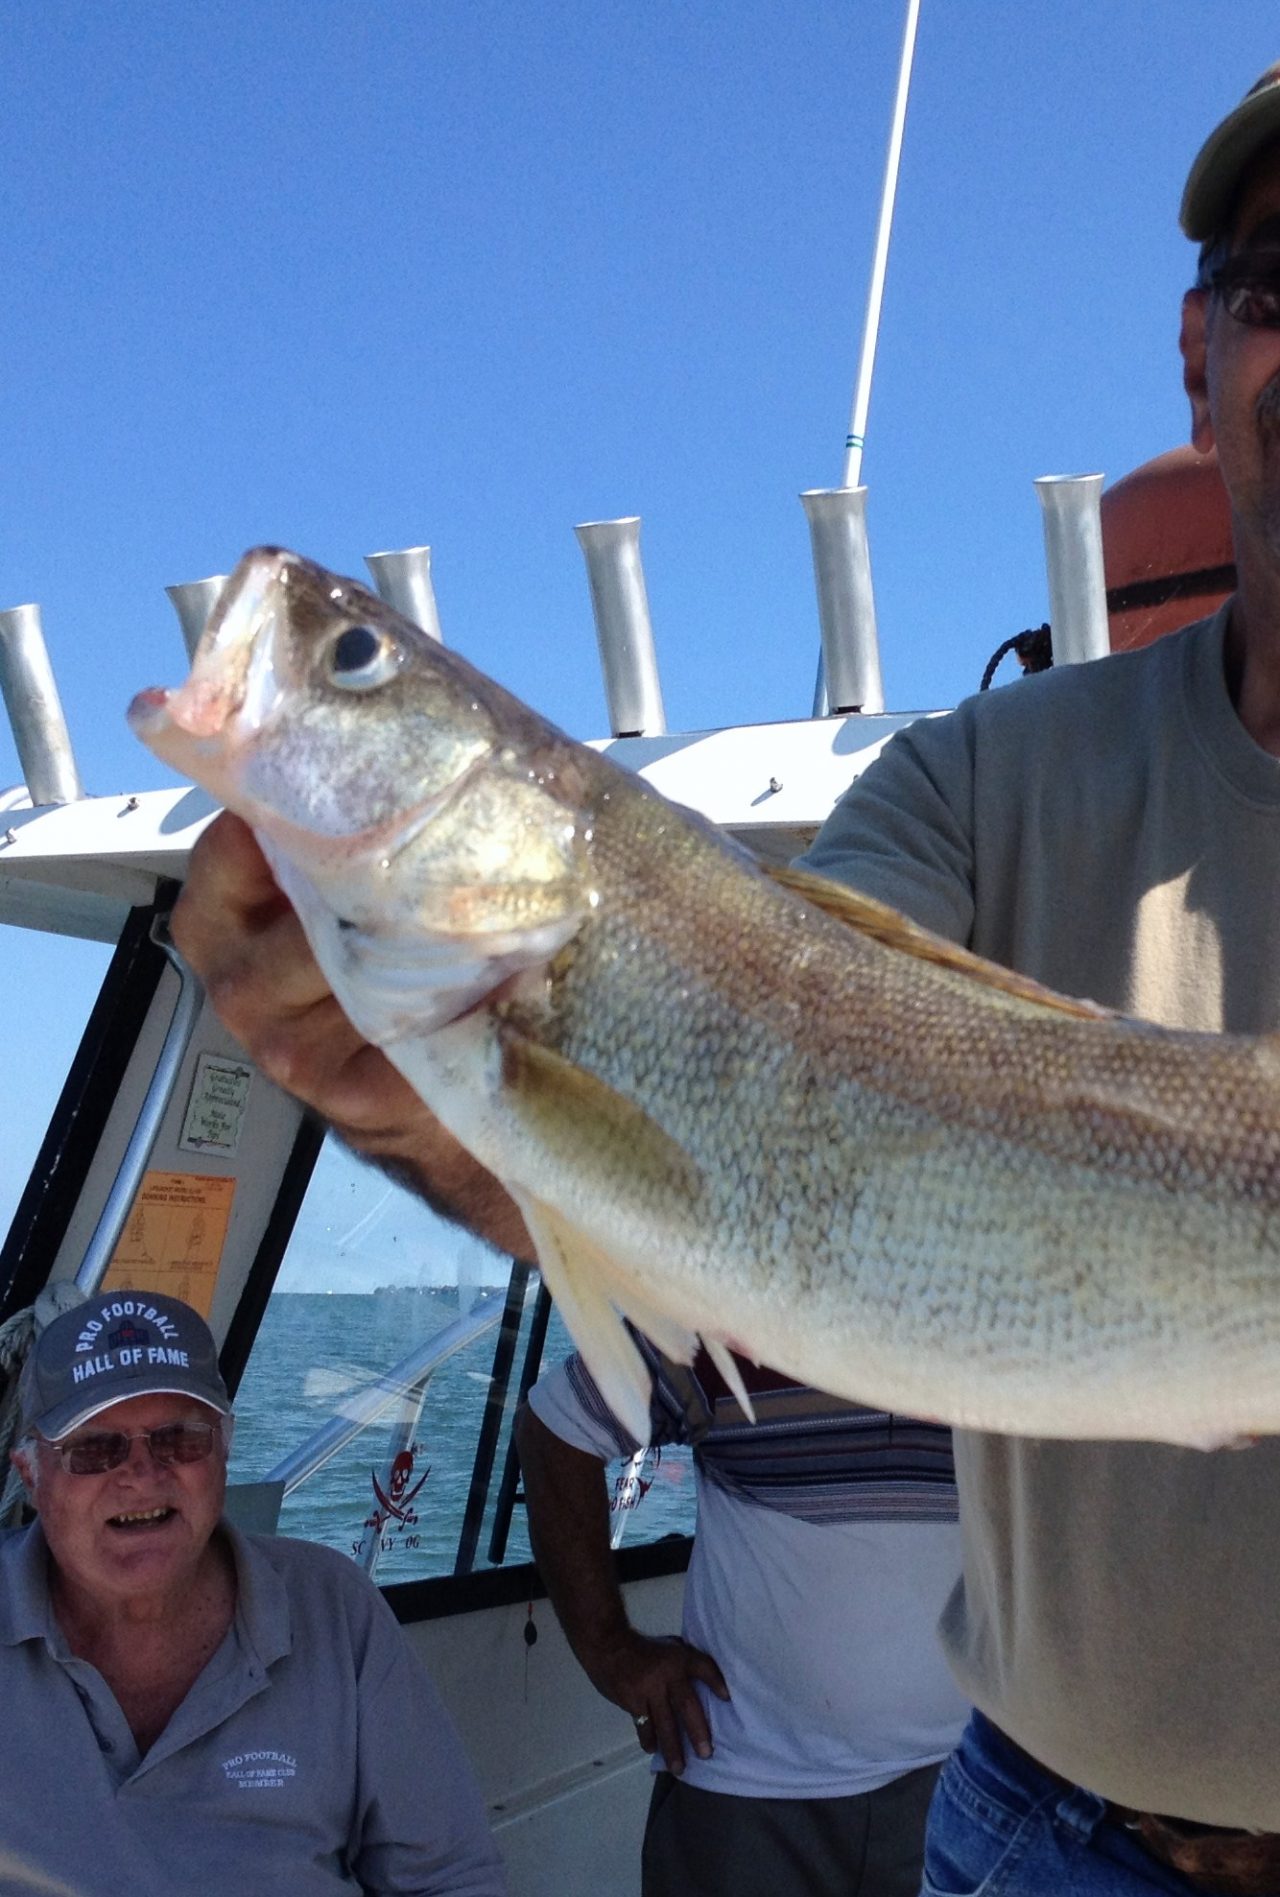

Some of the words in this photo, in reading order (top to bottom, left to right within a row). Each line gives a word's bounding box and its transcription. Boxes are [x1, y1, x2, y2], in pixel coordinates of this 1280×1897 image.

[75, 1319, 103, 1353] PRO
[100, 1300, 180, 1341] FOOTBALL
[72, 1353, 115, 1385] HALL
[119, 1348, 143, 1367] OF
[147, 1346, 190, 1369] FAME
[222, 1756, 244, 1770] PRO
[244, 1751, 298, 1768] FOOTBALL
[238, 1779, 284, 1788] MEMBER
